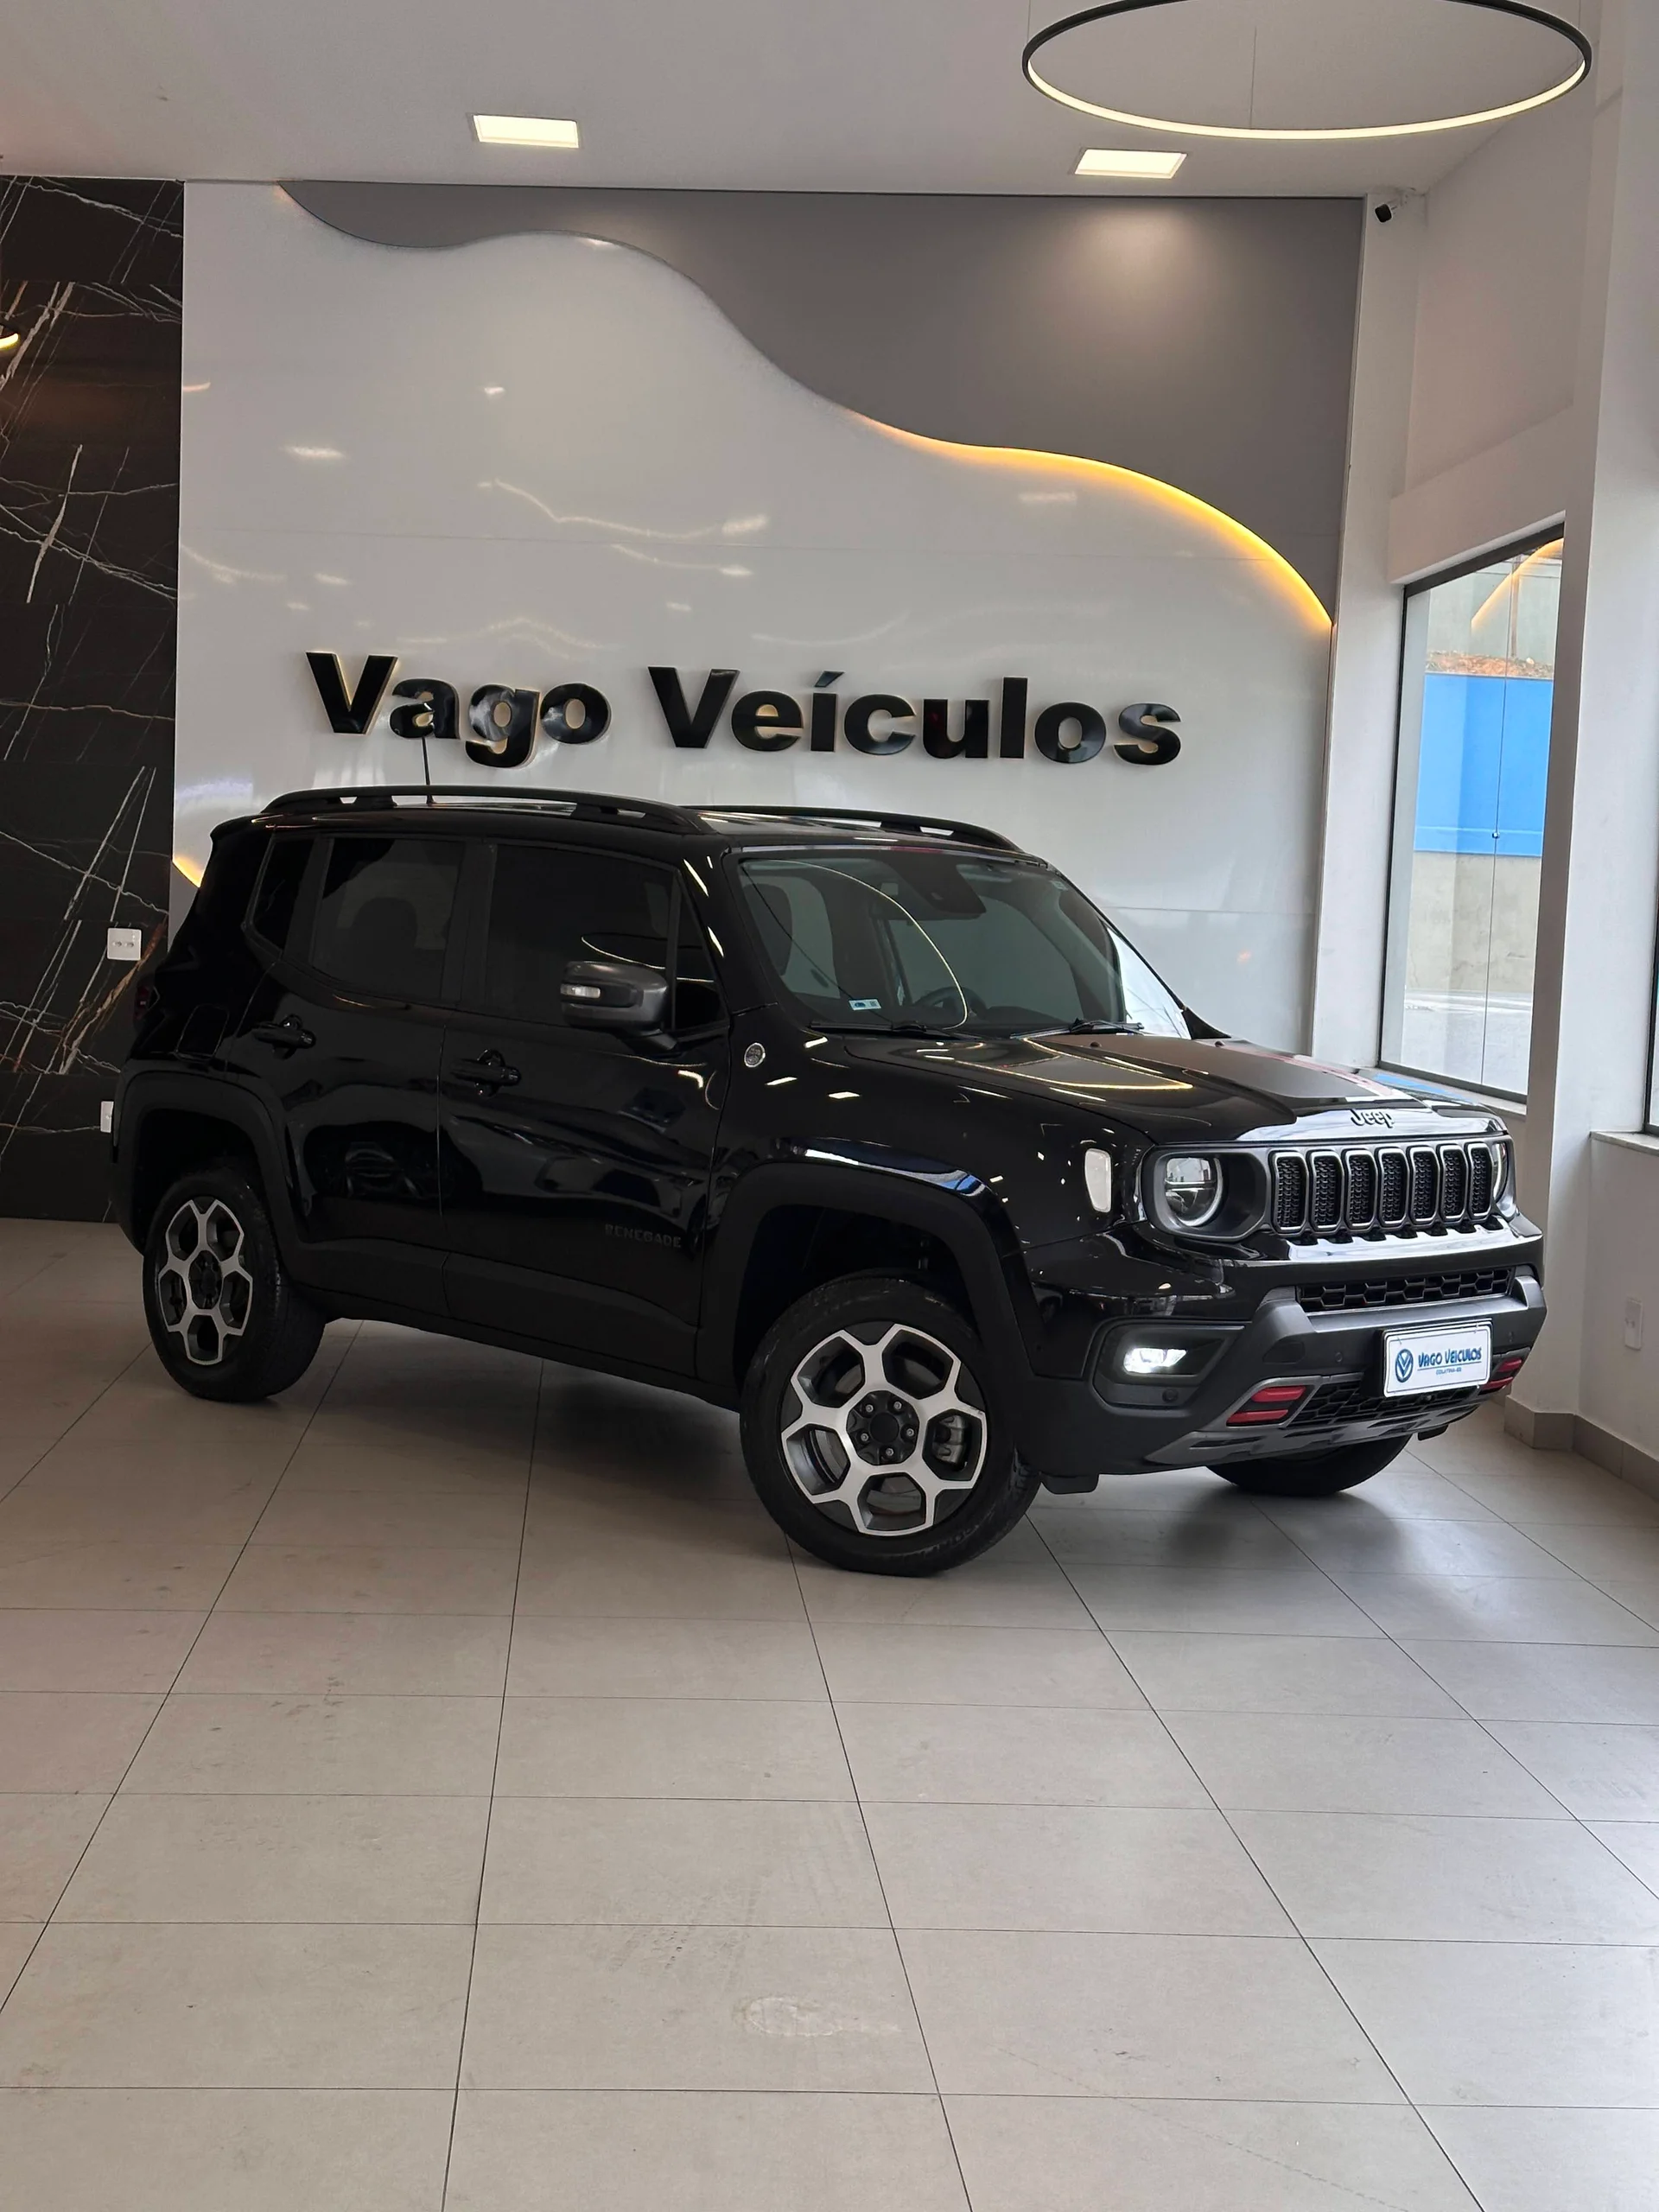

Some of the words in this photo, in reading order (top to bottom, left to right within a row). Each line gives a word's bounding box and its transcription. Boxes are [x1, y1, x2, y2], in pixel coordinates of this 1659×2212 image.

[305, 651, 611, 768] Vago
[648, 667, 1183, 767] Veículos
[1351, 1109, 1395, 1128] Jeep
[605, 1223, 681, 1248] RENEGADE
[1418, 1351, 1443, 1368] VAGO
